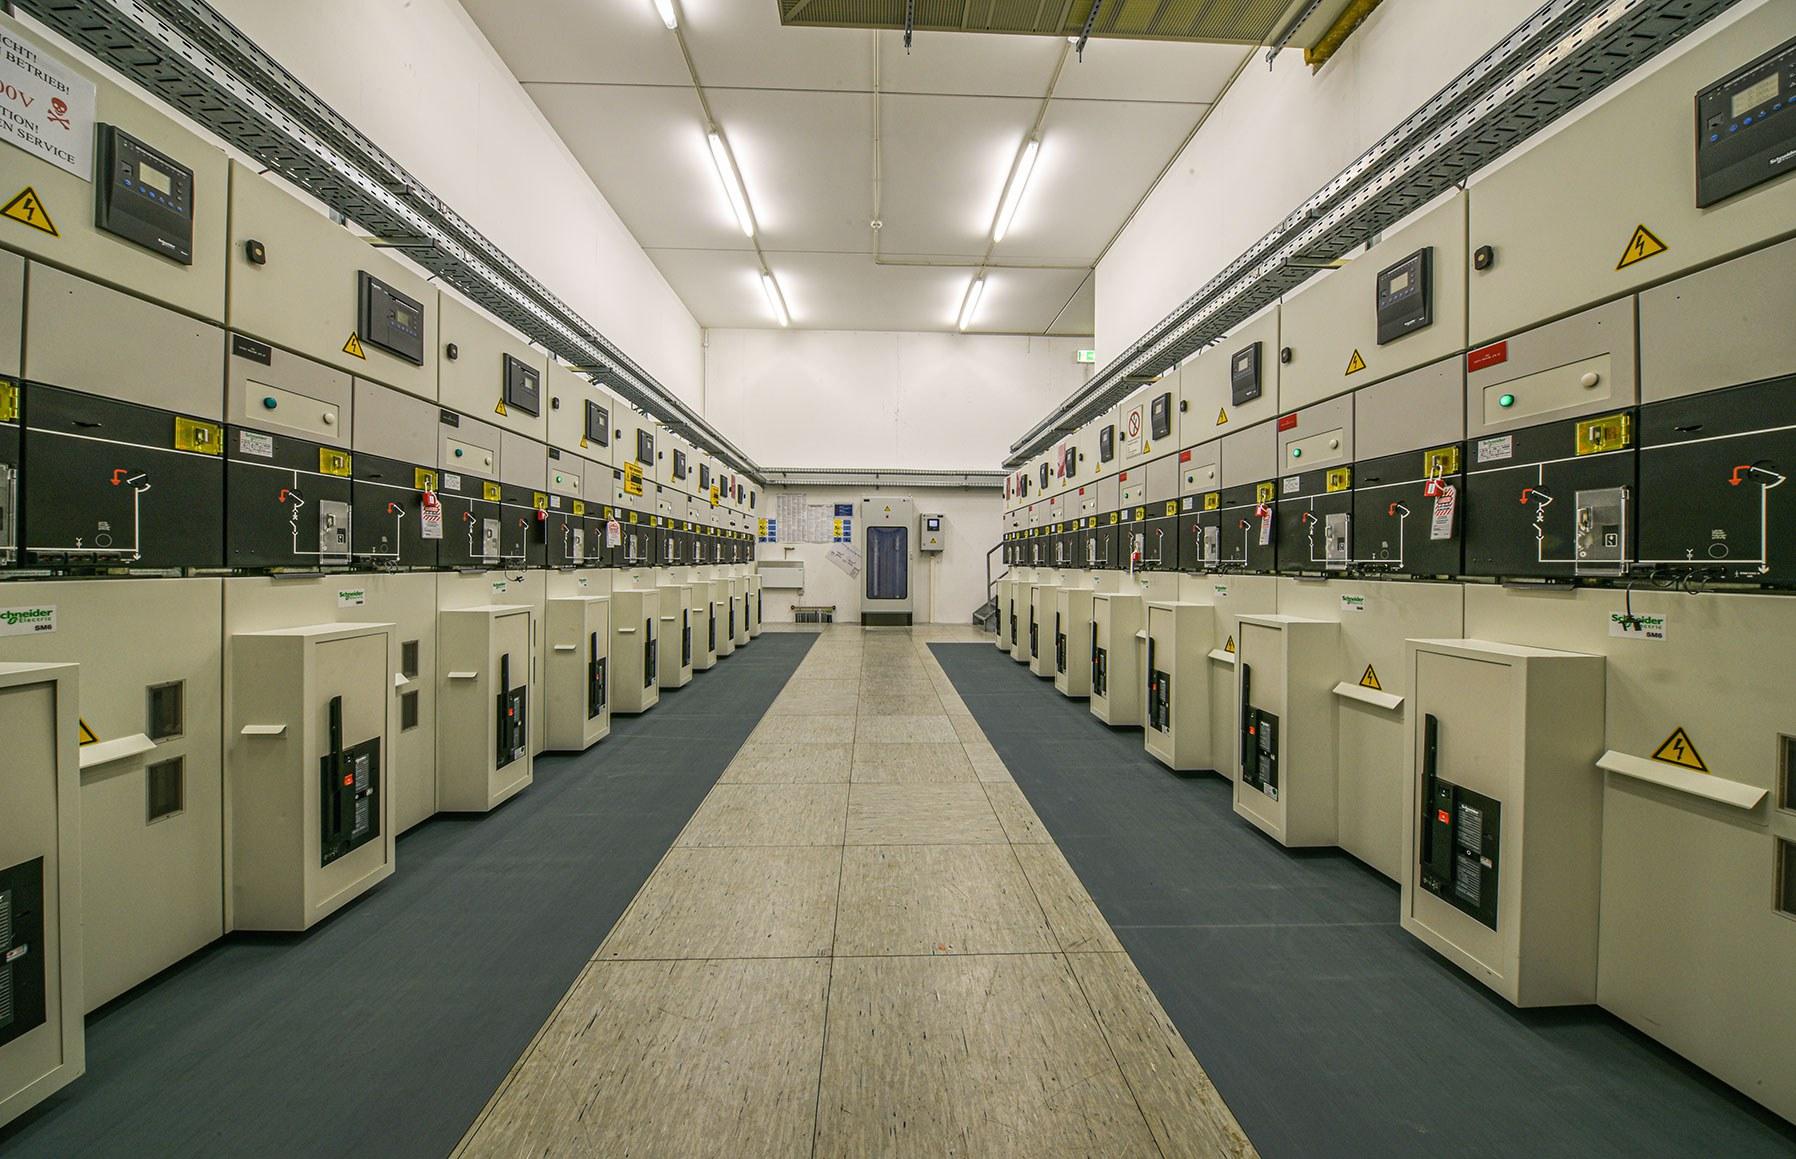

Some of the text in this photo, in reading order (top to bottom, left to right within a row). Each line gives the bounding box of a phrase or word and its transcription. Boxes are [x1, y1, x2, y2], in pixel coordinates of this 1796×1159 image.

[0, 33, 37, 64] CHT!
[6, 51, 70, 95] BETRIEB!
[17, 128, 76, 164] SERVICE
